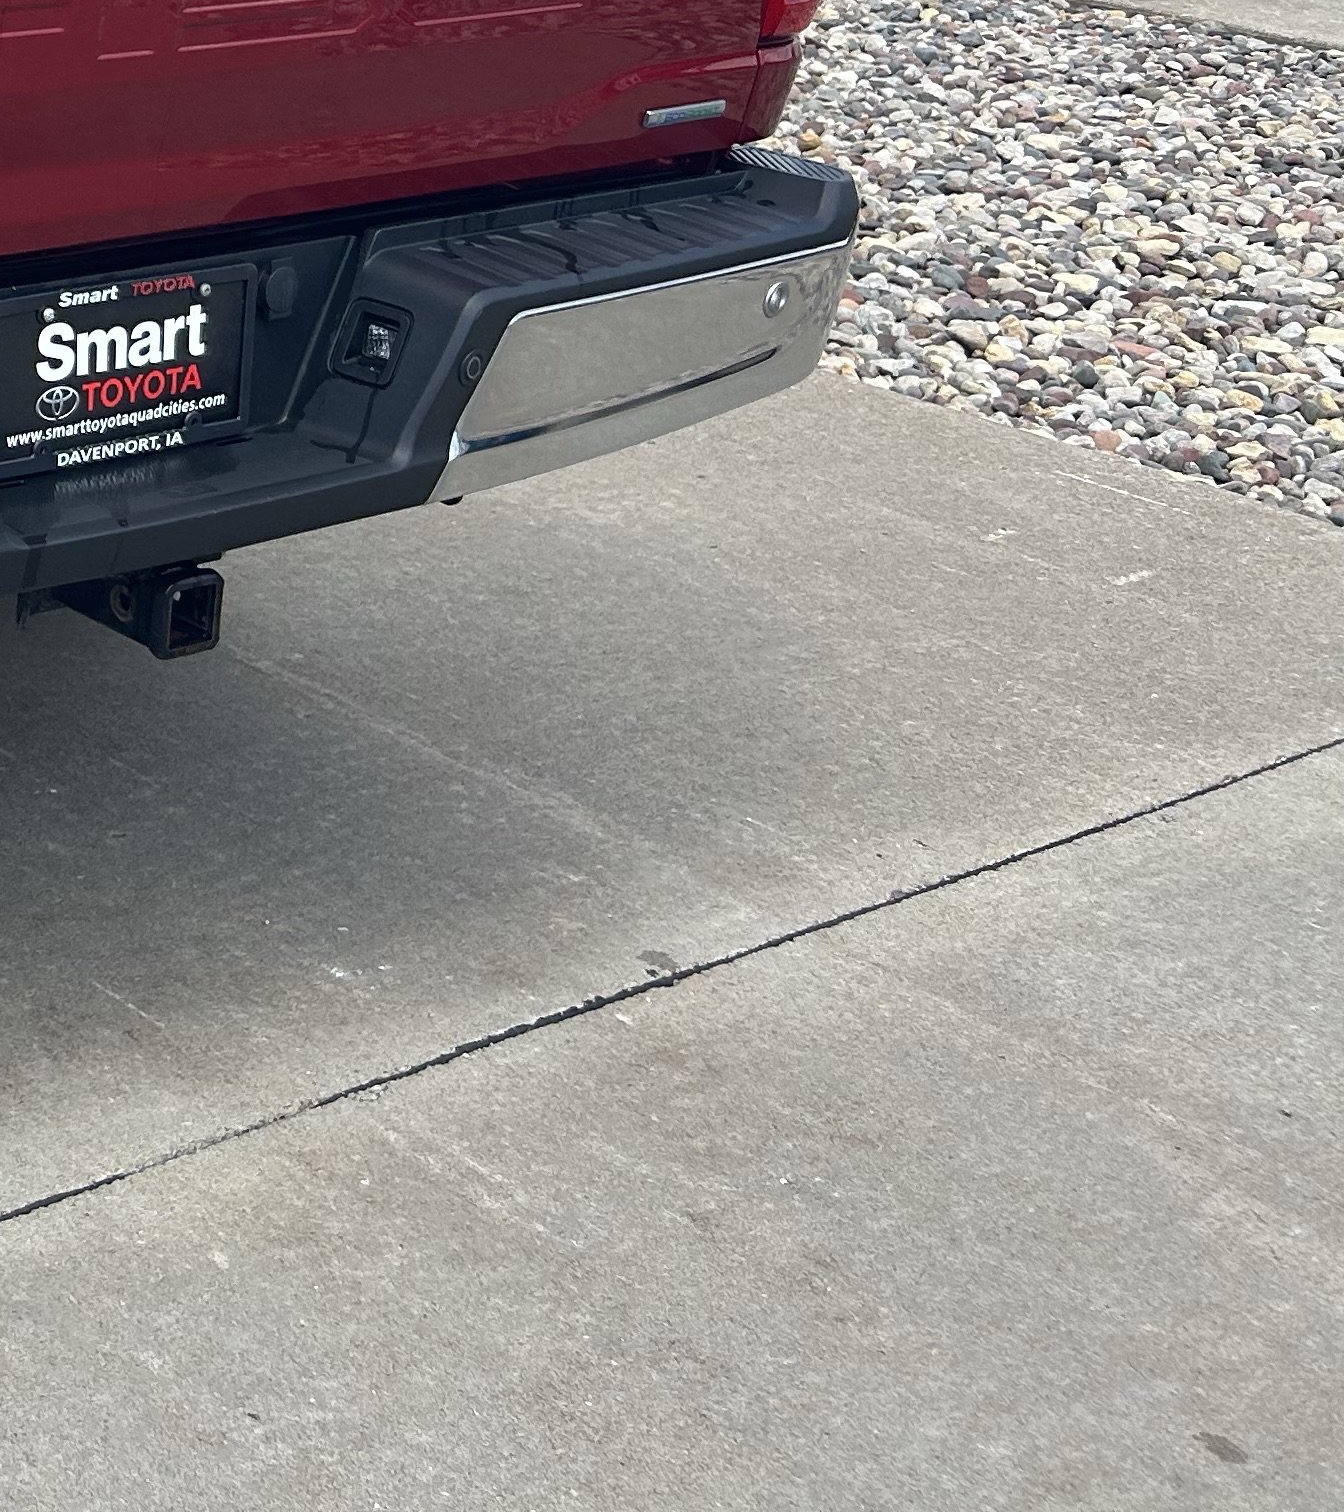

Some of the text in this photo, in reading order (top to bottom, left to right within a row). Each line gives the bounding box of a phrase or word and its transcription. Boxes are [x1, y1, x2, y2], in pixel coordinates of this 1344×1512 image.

[58, 274, 196, 308] Smart TOYOTA
[35, 303, 208, 382] Smart
[81, 363, 204, 413] TOYOTA
[5, 393, 226, 448] www.smarttoyotaquadcities.com
[56, 430, 184, 468] DAVENPORT, IA
